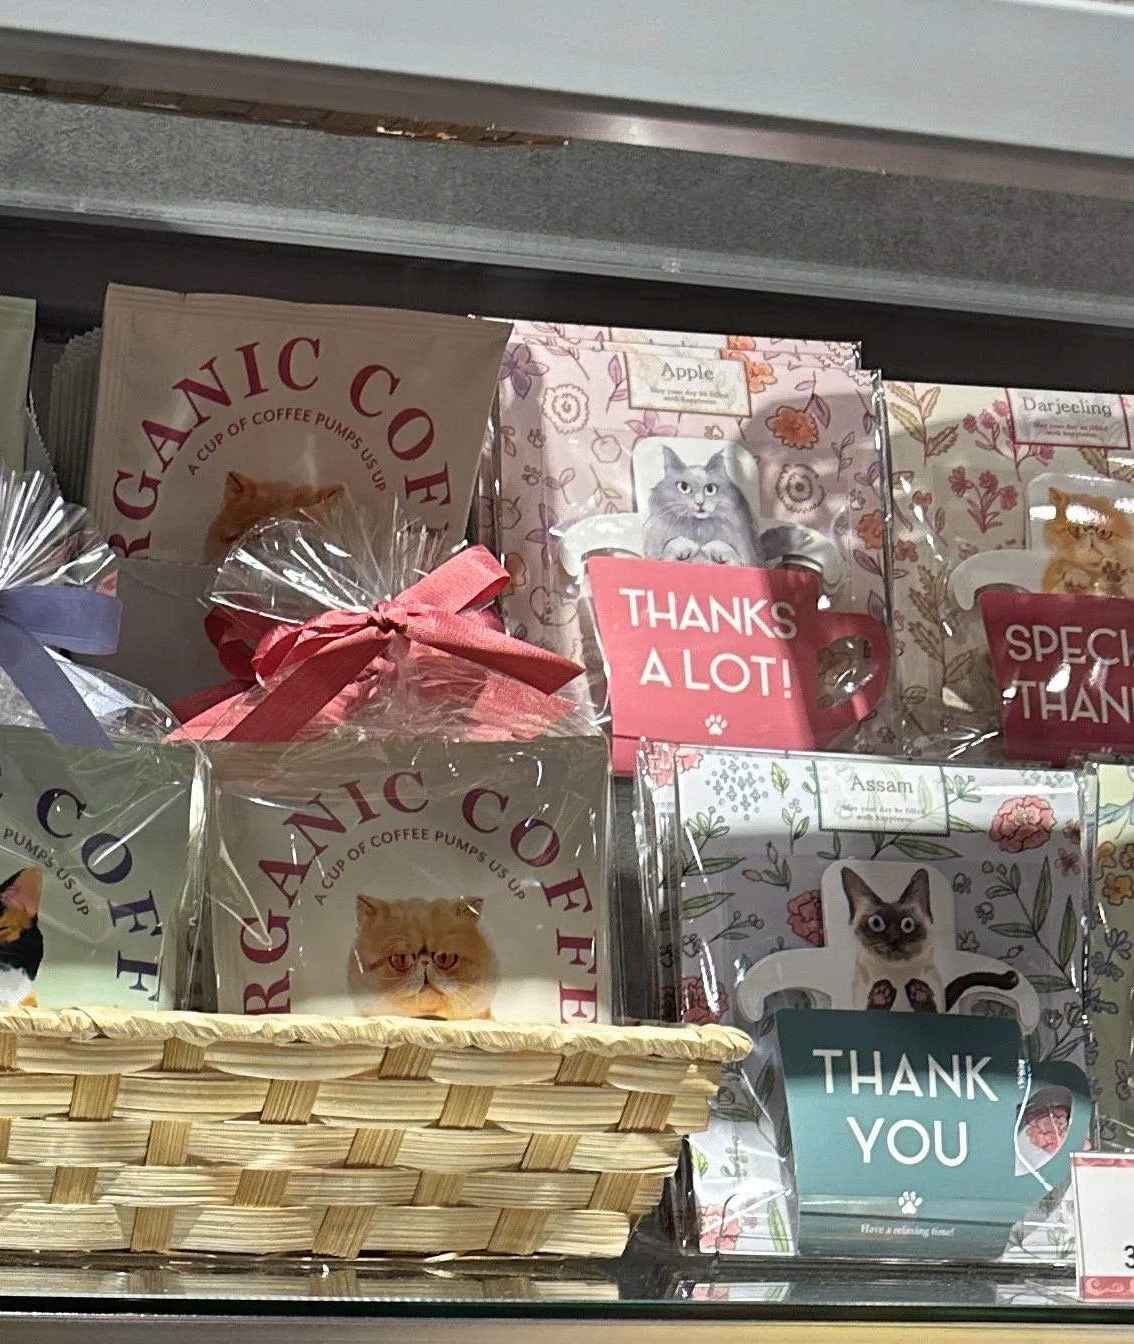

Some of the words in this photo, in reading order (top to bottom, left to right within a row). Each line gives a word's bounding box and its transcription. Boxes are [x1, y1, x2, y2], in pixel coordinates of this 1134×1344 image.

[661, 362, 714, 381] Apple
[1022, 396, 1112, 417] Darjeeling
[187, 463, 200, 476] A
[196, 433, 224, 462] CUP
[227, 417, 247, 437] OF
[252, 407, 312, 426] COFFEE
[315, 412, 363, 450] PUMPS
[360, 447, 378, 470] US
[372, 469, 387, 492] UP
[619, 587, 796, 640] THANKS
[640, 648, 676, 687] A
[683, 653, 793, 699] LOT!
[850, 774, 913, 793] Assam
[3, 827, 56, 869] PUMPS
[56, 866, 77, 890] US
[72, 892, 90, 916] UP
[314, 893, 327, 906] A
[321, 859, 346, 890] CUP
[347, 842, 367, 861] OF
[370, 828, 430, 849] COFFEE
[434, 830, 487, 864] PUMPS
[488, 859, 509, 879] US
[508, 878, 526, 901] UP
[813, 1049, 998, 1101] THANK
[846, 1116, 967, 1167] YOU
[861, 1224, 885, 1234] Have
